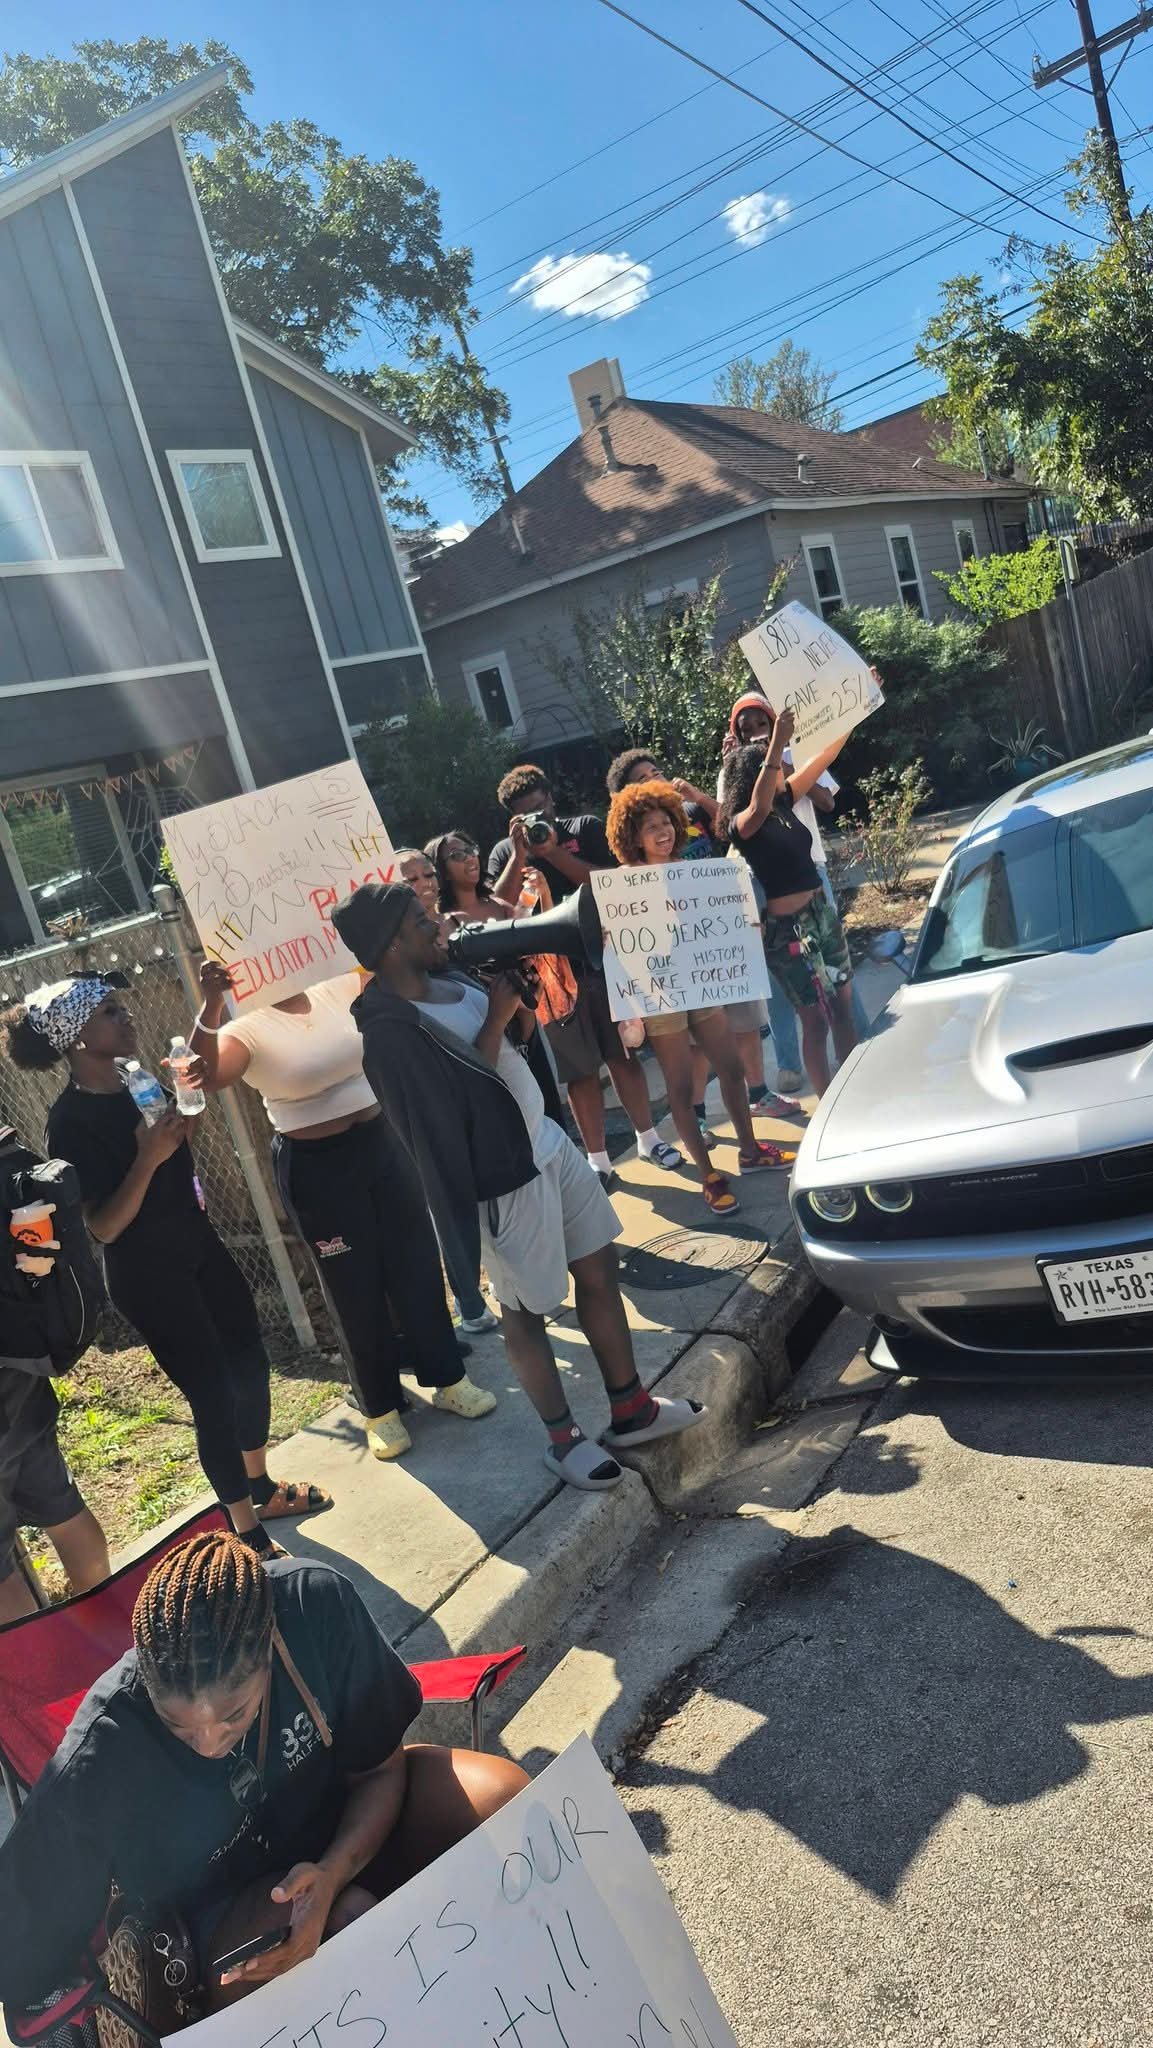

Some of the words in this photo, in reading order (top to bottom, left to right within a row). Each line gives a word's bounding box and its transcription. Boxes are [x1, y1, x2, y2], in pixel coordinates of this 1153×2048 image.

[758, 613, 801, 665] 1875
[802, 631, 845, 672] NEVER
[308, 864, 396, 922] BLK
[597, 875, 612, 891] 10
[624, 871, 660, 888] YEARS
[667, 868, 685, 881] OF
[691, 865, 743, 880] OCCUPATION
[606, 900, 649, 919] DOES
[666, 898, 699, 912] NOT
[708, 893, 750, 907] OVERRIDE
[608, 926, 656, 955] 100
[666, 916, 729, 947] YEARS
[734, 914, 750, 930] OF
[646, 954, 675, 971] OUR
[693, 945, 745, 967] HISTORY
[616, 979, 644, 1000] WE
[650, 973, 682, 993] ARE
[691, 964, 749, 985] FOREVER
[644, 990, 688, 1013] EAST
[701, 982, 750, 1001] AUSTIN
[1084, 1258, 1135, 1274] TEXAS
[394, 1900, 477, 2005] IS
[501, 1796, 609, 1904] OUR
